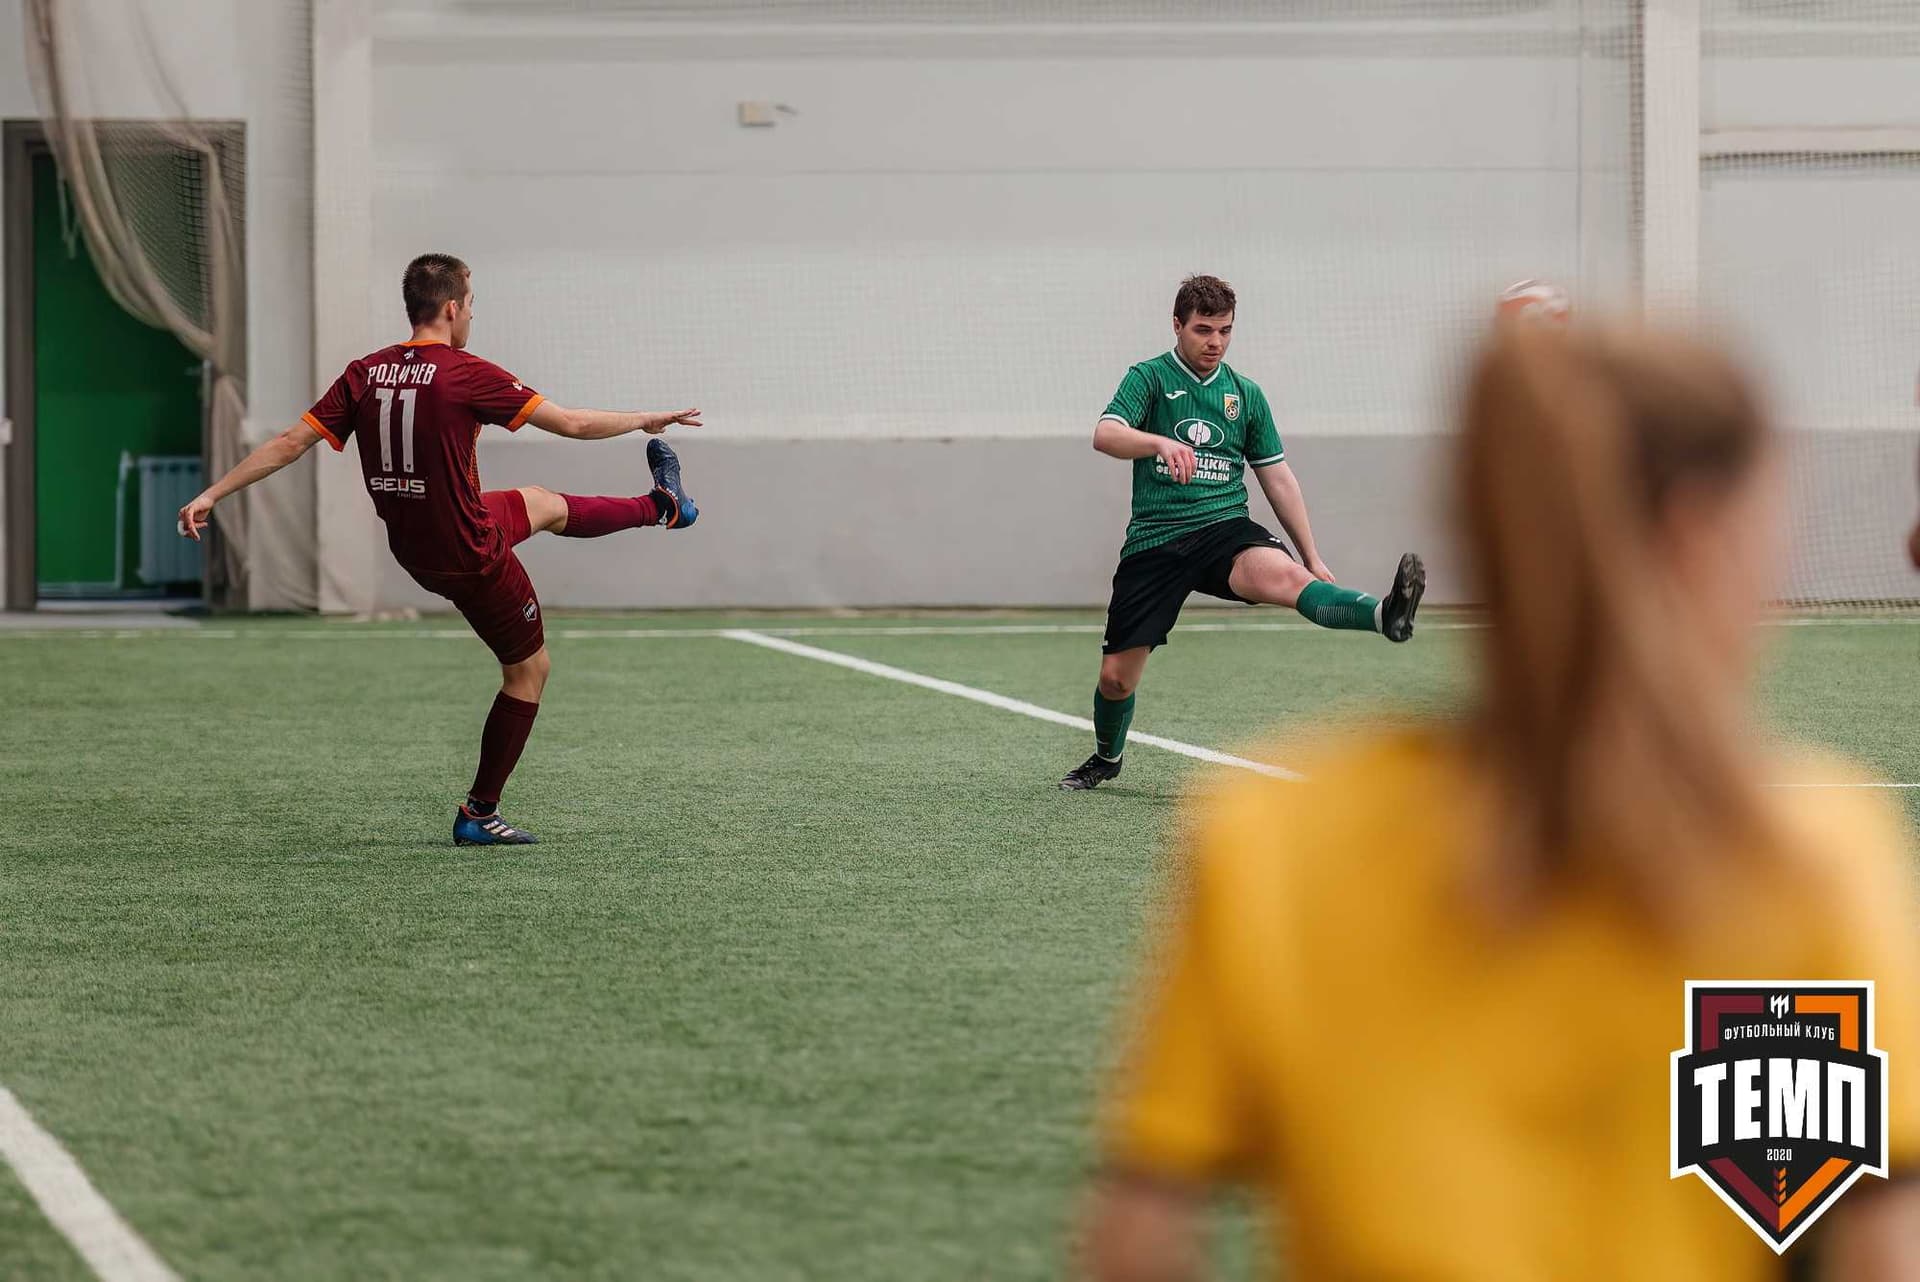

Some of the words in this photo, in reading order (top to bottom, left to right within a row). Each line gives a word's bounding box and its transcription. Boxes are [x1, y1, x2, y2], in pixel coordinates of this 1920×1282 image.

[367, 362, 437, 387] РОДИЧЕВ
[375, 387, 417, 473] 11
[370, 477, 426, 494] SEUS
